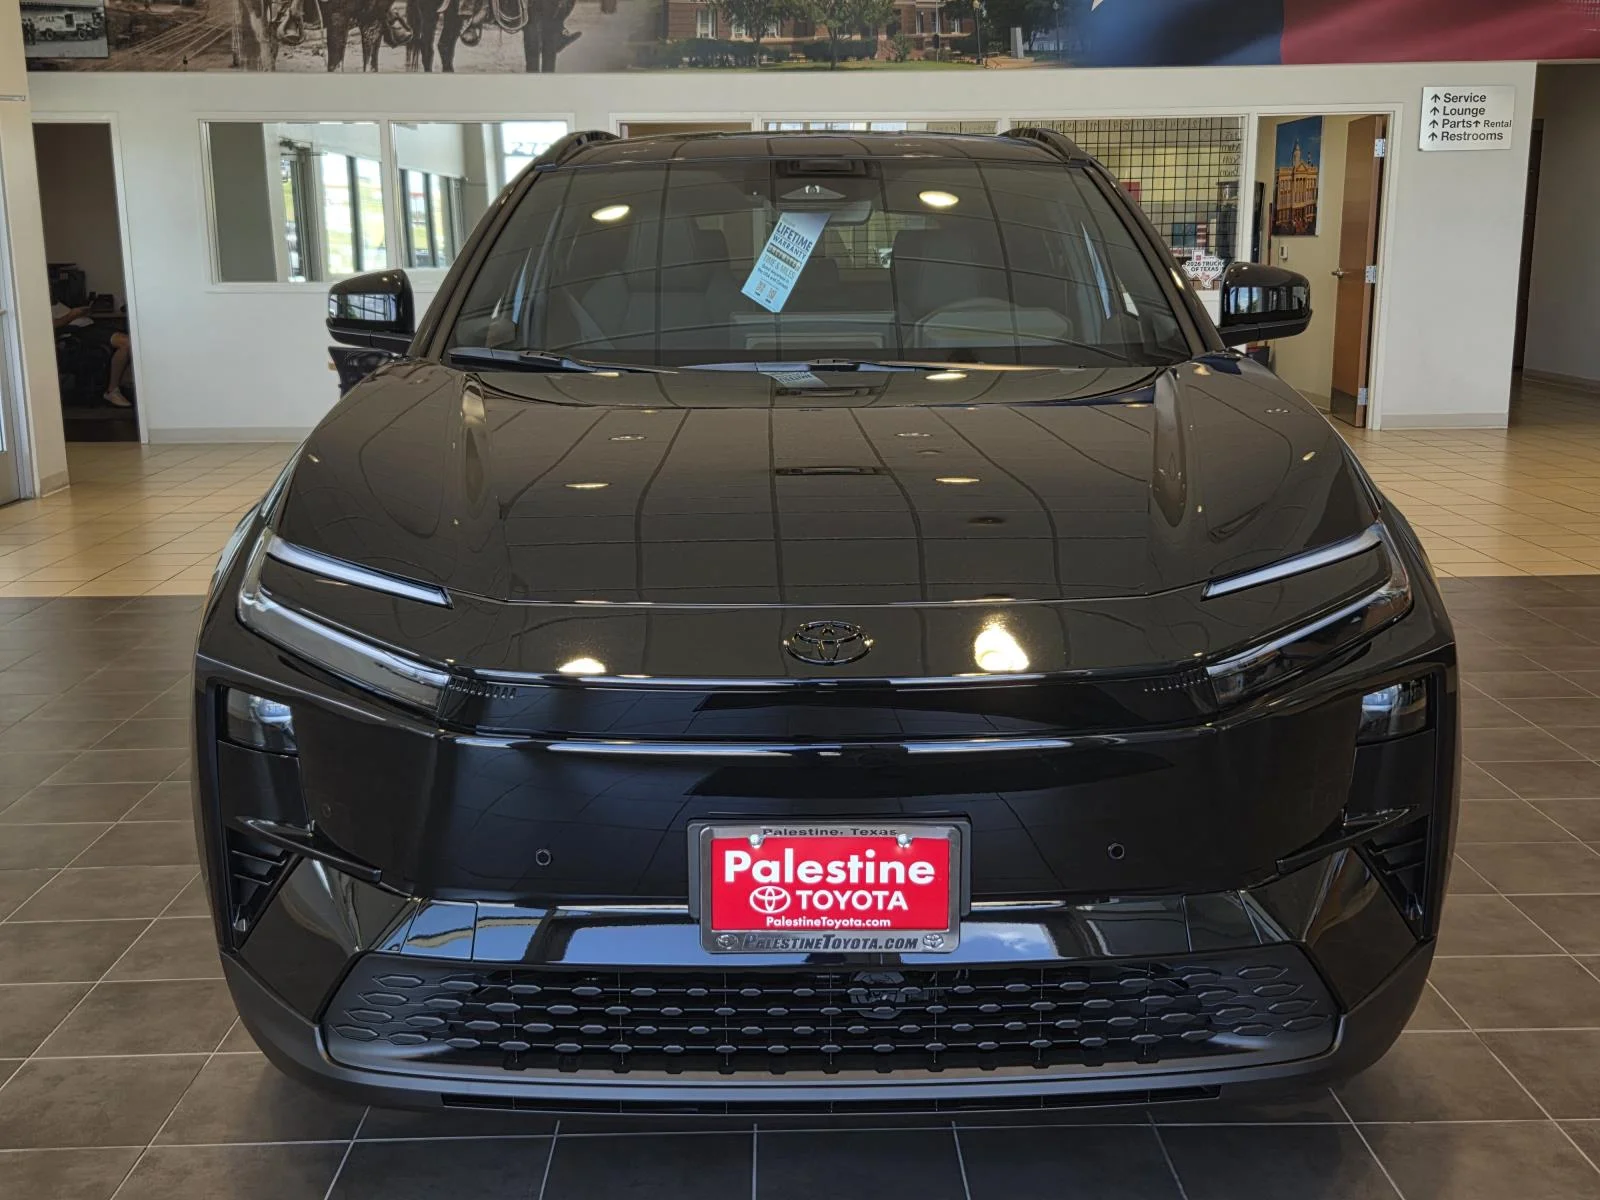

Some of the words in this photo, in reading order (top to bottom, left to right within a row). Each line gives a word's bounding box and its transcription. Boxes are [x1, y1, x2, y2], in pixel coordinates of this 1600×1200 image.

[1443, 92, 1487, 103] Service
[1442, 106, 1486, 117] Lounge
[1441, 119, 1472, 129] Parts
[1483, 119, 1512, 128] Rental
[1440, 131, 1504, 141] Restrooms
[776, 223, 813, 252] LIFETIME
[772, 235, 807, 260] WARRANTY
[850, 828, 897, 836] Texas
[724, 848, 935, 884] Palestine
[796, 889, 909, 911] TOYOTA
[766, 916, 891, 929] PalestineToyota.com
